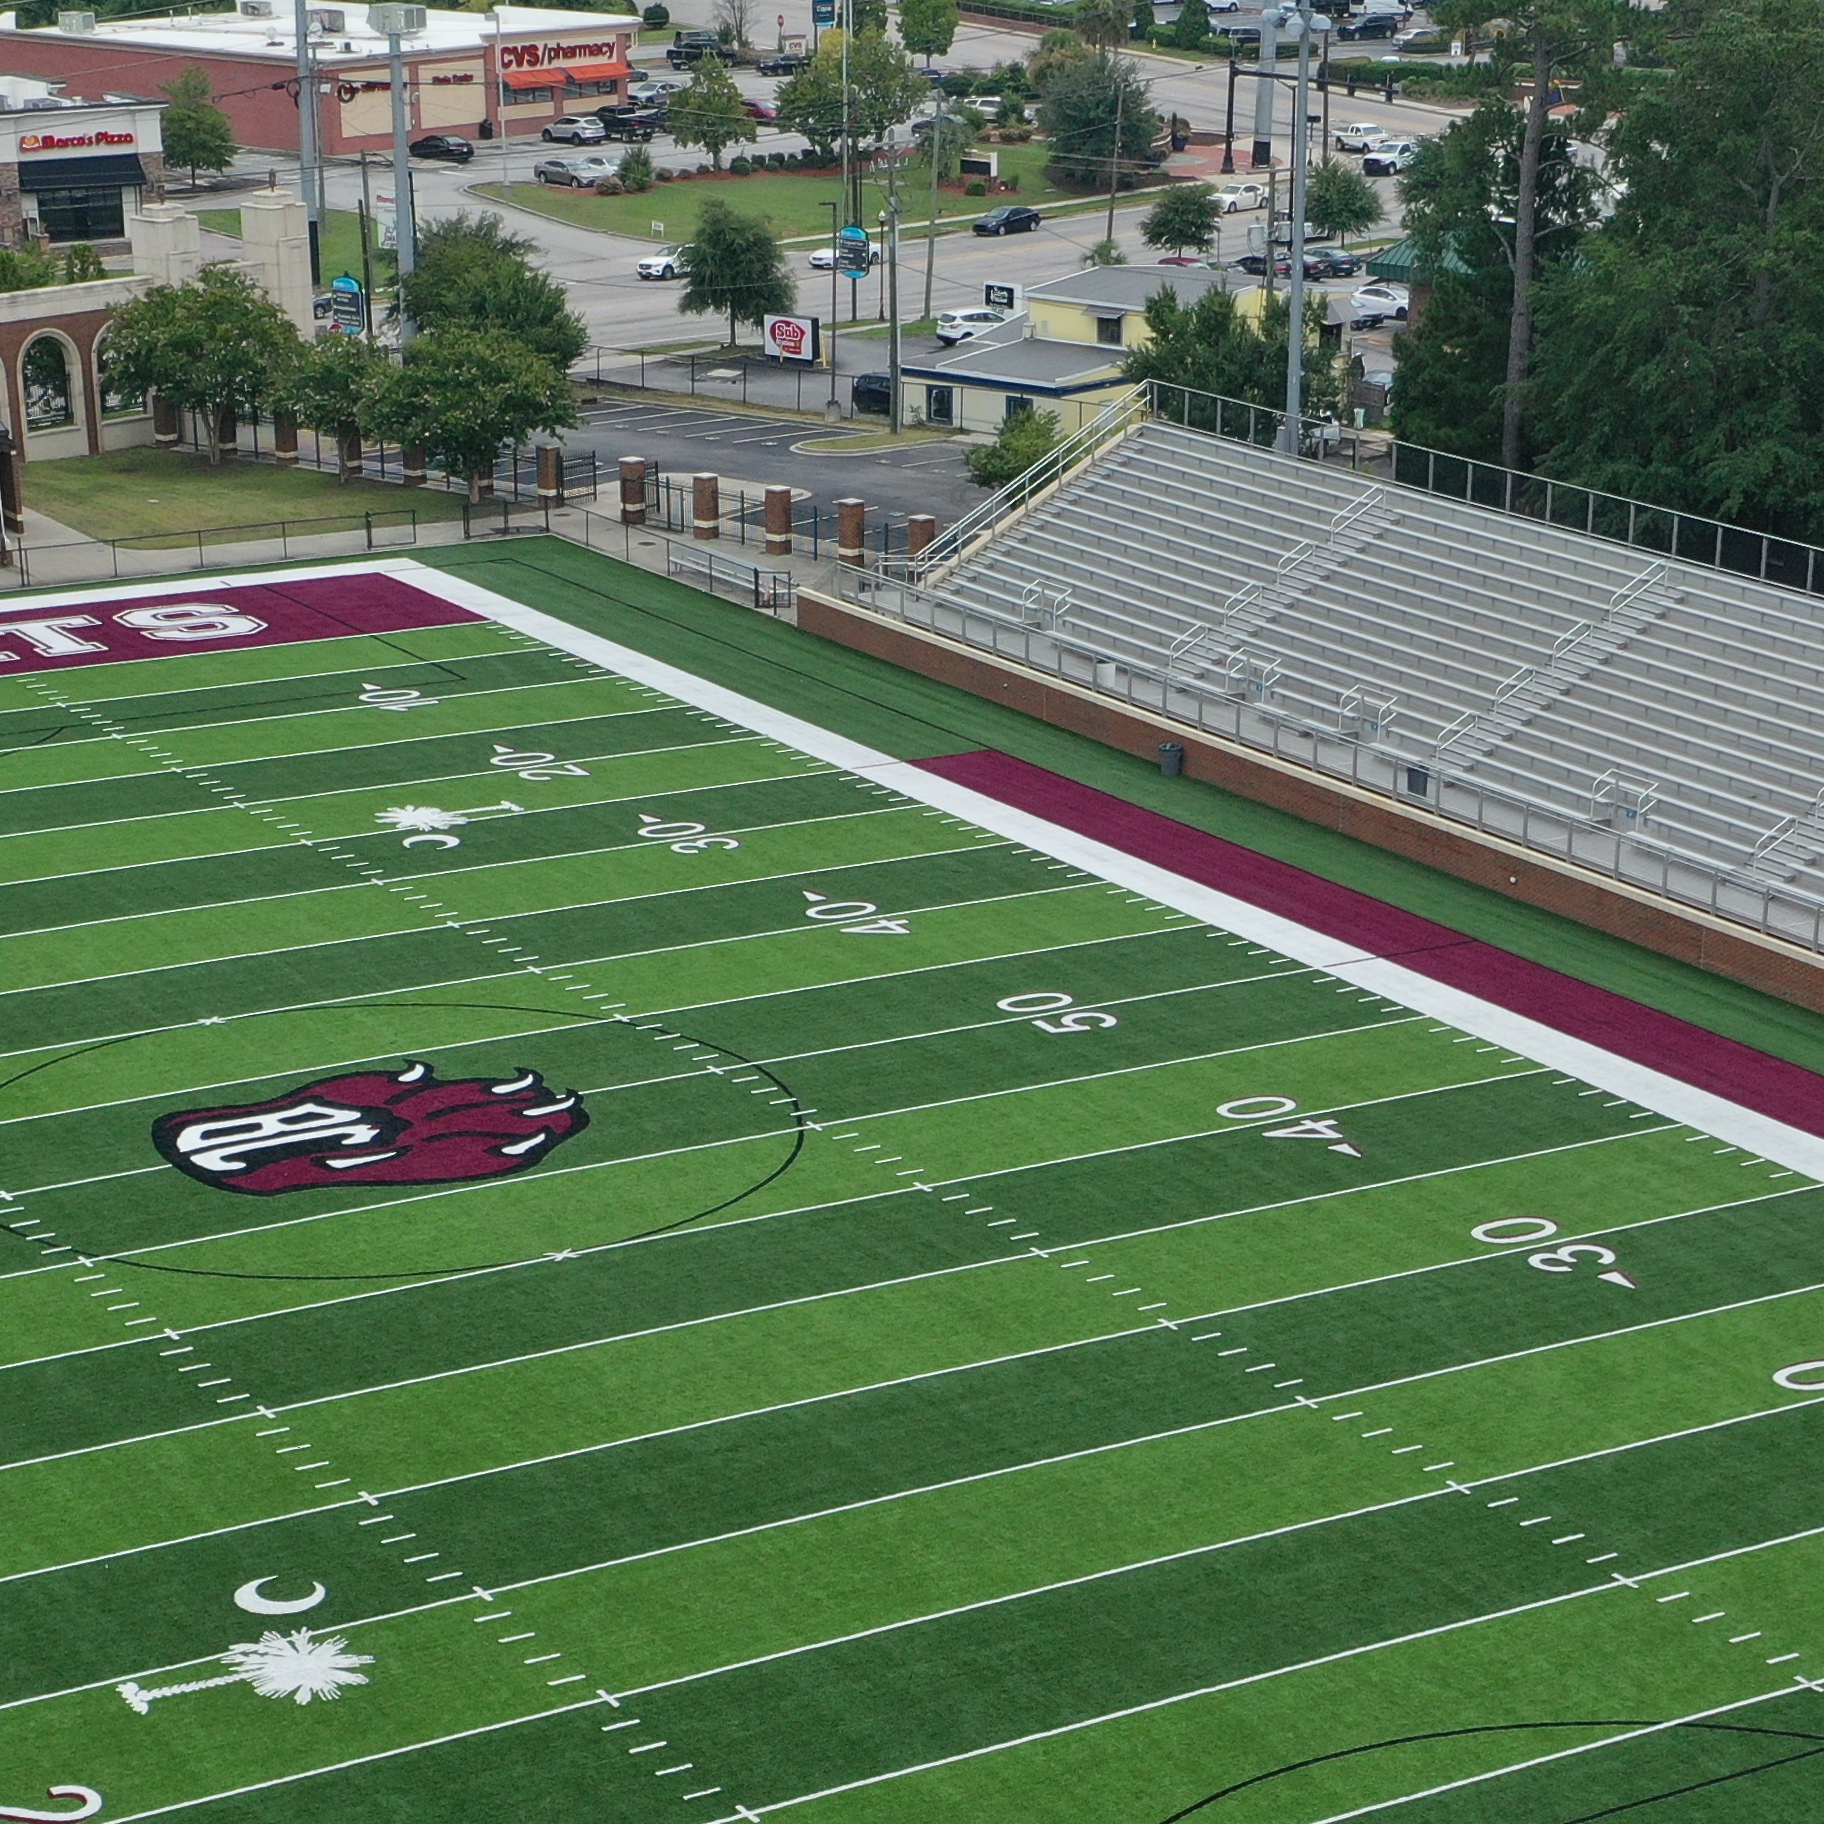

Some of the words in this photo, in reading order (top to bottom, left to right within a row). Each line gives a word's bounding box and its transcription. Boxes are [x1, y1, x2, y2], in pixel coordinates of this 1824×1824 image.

[501, 41, 616, 69] CVS/pharmacy
[41, 134, 94, 149] Marco's
[95, 131, 134, 145] Pizza
[776, 323, 801, 340] Sub
[490, 752, 591, 781] 20
[638, 822, 740, 854] 30
[806, 901, 911, 935] 40
[996, 992, 1118, 1034] 50
[1216, 1096, 1344, 1140] 40
[1470, 1216, 1617, 1273] 30
